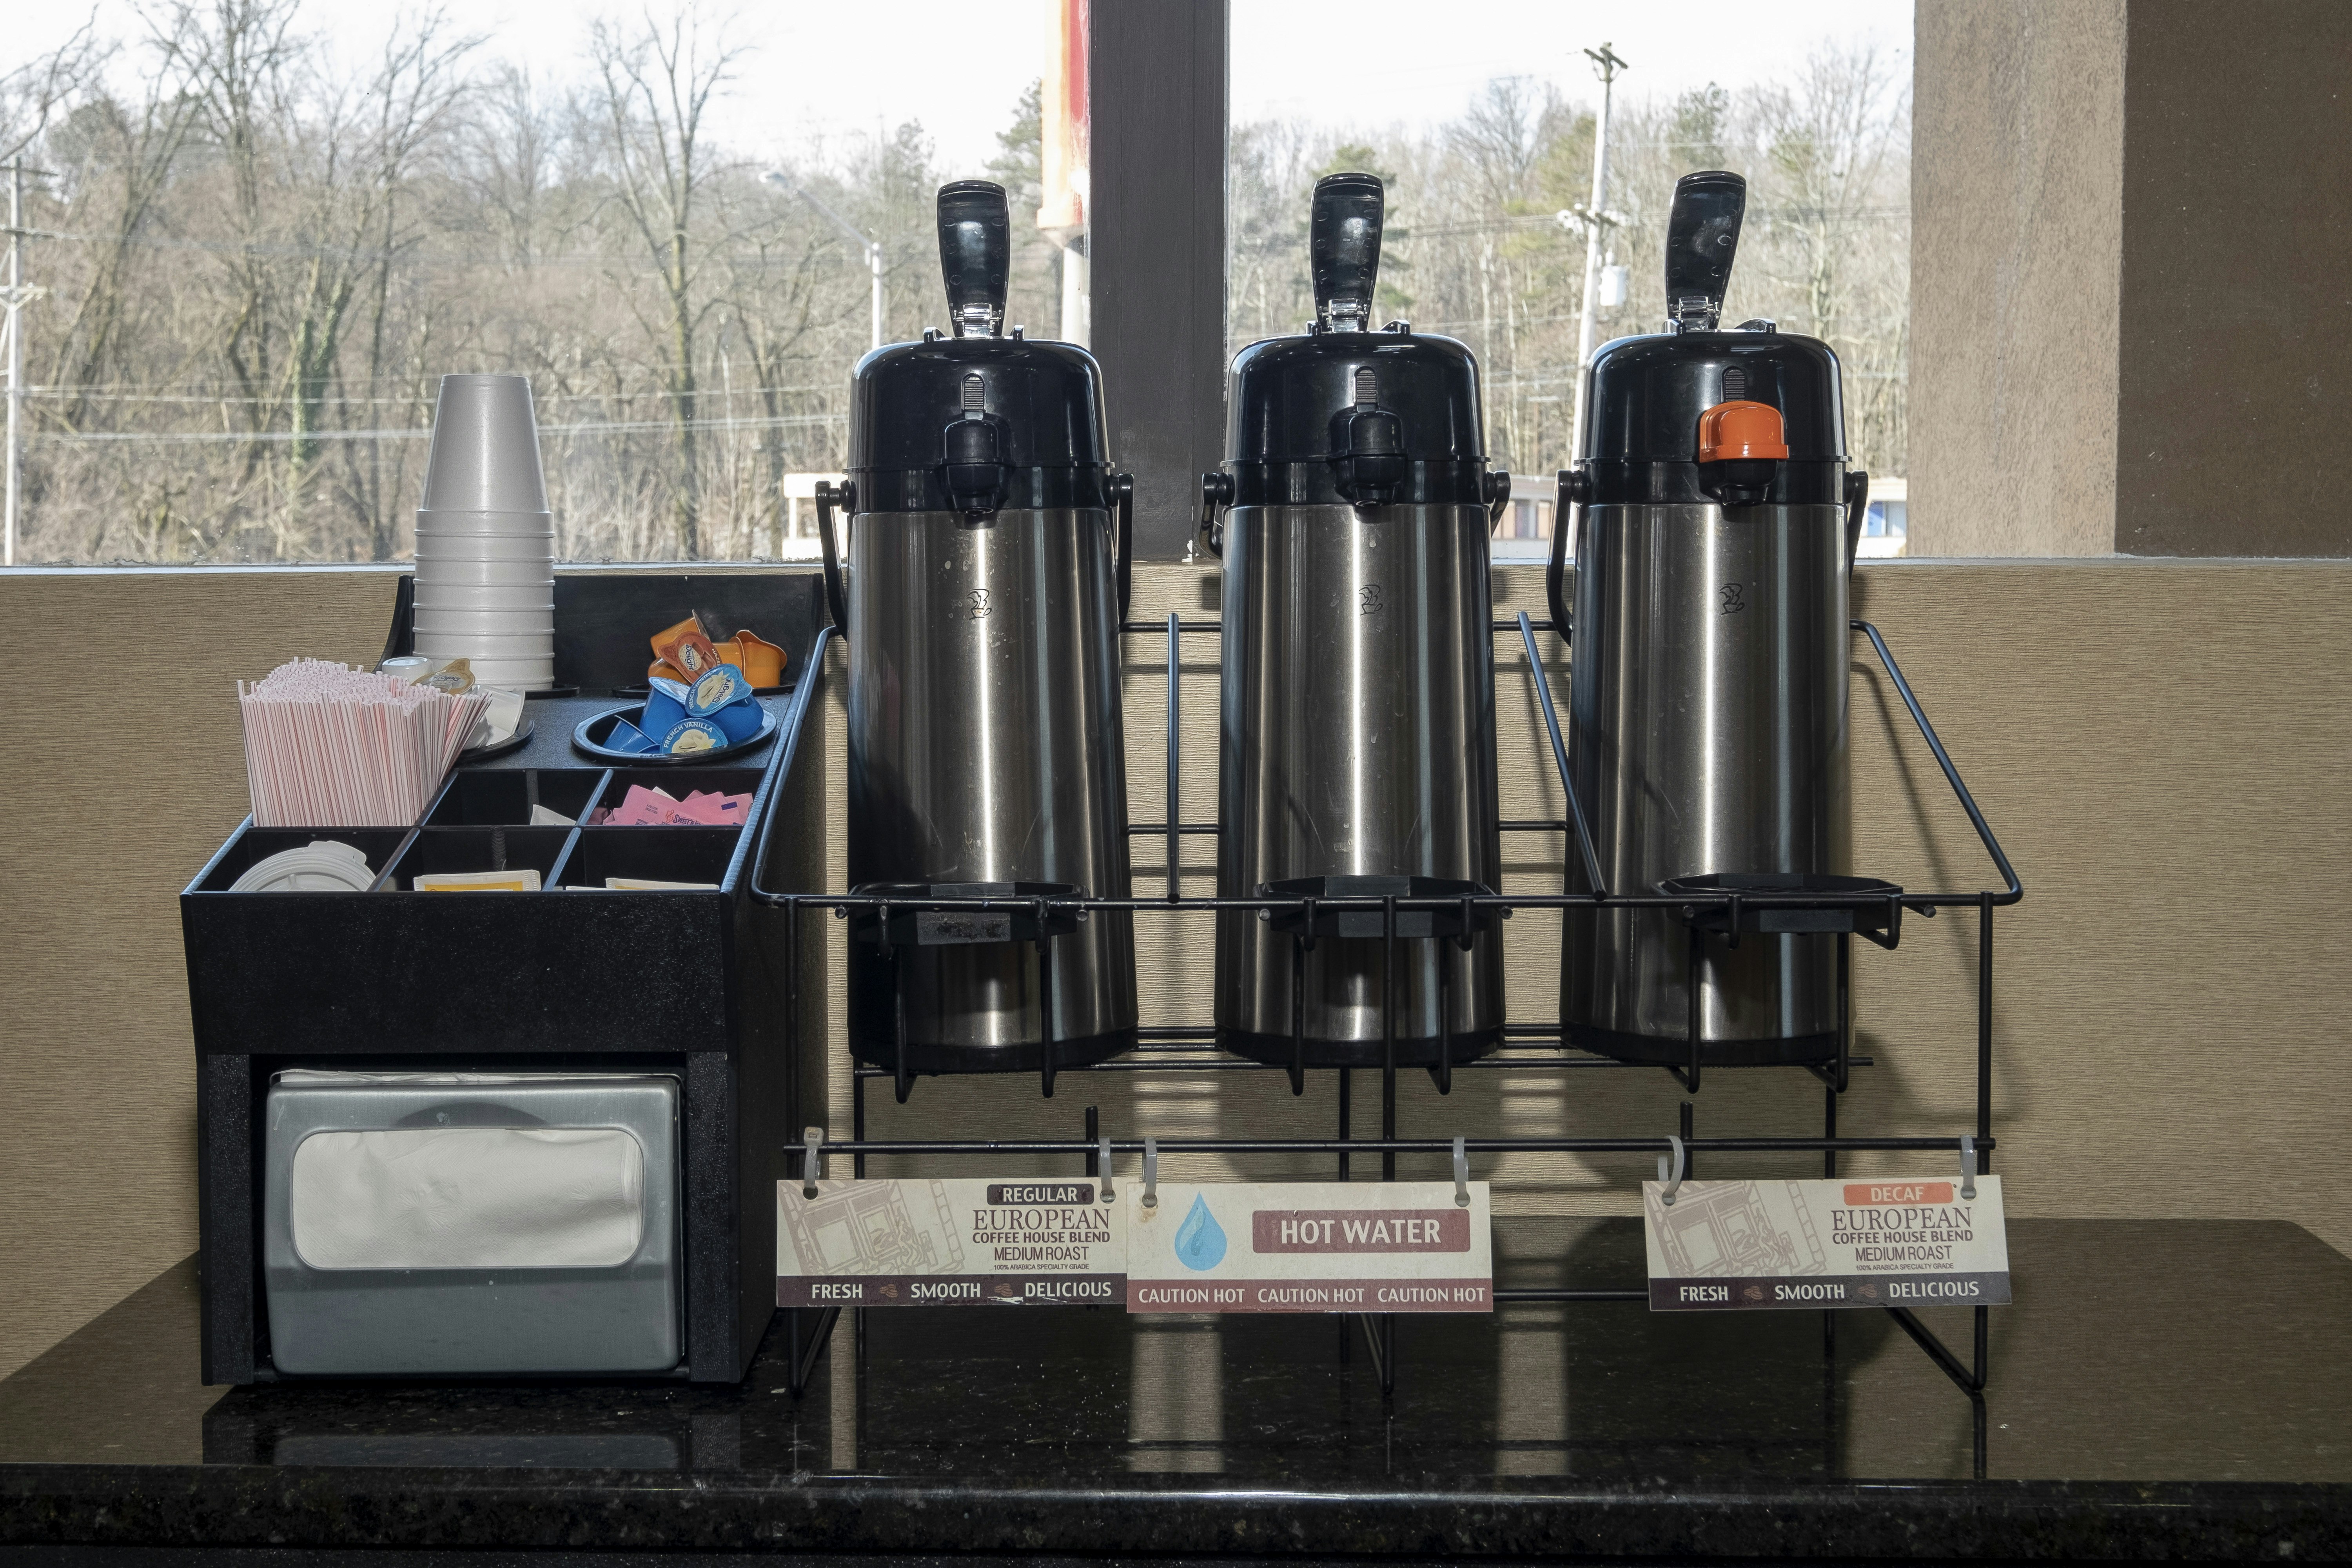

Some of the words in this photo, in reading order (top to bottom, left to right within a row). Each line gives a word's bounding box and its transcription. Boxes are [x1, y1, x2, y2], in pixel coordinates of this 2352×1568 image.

[685, 644, 693, 670] Delight
[712, 678, 732, 703] Delight
[664, 725, 684, 748] FRENCH
[684, 722, 713, 733] VANILLA
[1003, 1187, 1077, 1202] REGULAR
[1871, 1186, 1924, 1202] DECAF
[973, 1209, 1110, 1230] EUROPEAN
[1831, 1207, 1972, 1231] EUROPEAN
[973, 1232, 1019, 1243] COFFEE
[1024, 1232, 1065, 1243] HOUSE
[1069, 1232, 1110, 1242] BLEND
[1282, 1220, 1335, 1244] HOT
[1343, 1220, 1441, 1243] WATER
[1833, 1232, 1880, 1244] COFFEE
[1884, 1231, 1927, 1243] HOUSE
[1931, 1230, 1973, 1241] BLEND
[995, 1247, 1042, 1261] MEDIUM
[1045, 1247, 1089, 1260] ROAST
[1856, 1247, 1906, 1262] MEDIUM
[1908, 1246, 1952, 1261] ROAST
[812, 1285, 862, 1299] FRESH
[911, 1284, 981, 1298] SMOOTH
[1025, 1283, 1111, 1297] DELICIOUS
[1139, 1289, 1209, 1303] CAUTION
[1214, 1289, 1245, 1303] HOT
[1258, 1289, 1328, 1303] CAUTION
[1334, 1289, 1364, 1302] HOT
[1378, 1289, 1449, 1302] CAUTION
[1454, 1288, 1485, 1302] HOT
[1680, 1287, 1728, 1301] FRESH
[1775, 1284, 1844, 1300] SMOOTH
[1889, 1281, 1979, 1298] DELICIOUS
